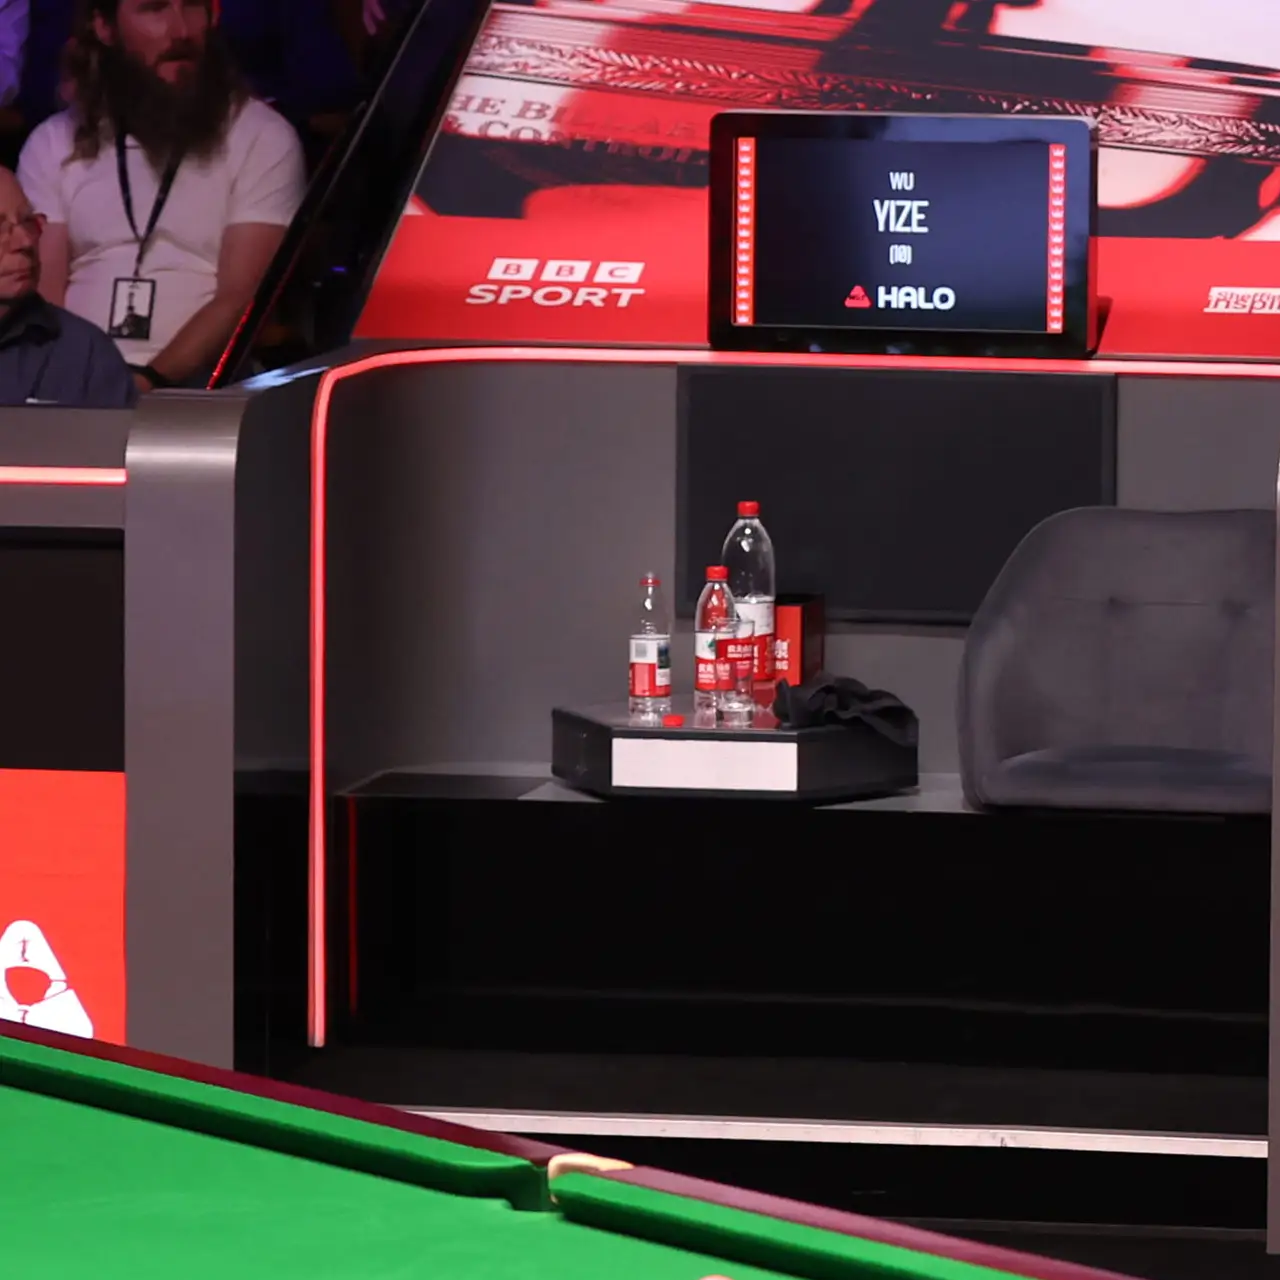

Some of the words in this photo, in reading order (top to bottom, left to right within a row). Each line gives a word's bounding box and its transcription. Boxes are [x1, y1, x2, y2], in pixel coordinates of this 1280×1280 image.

[889, 172, 914, 190] WU
[873, 199, 929, 233] YIZE
[492, 260, 641, 281] BBC
[465, 284, 645, 307] SPORT
[877, 286, 956, 310] HALO
